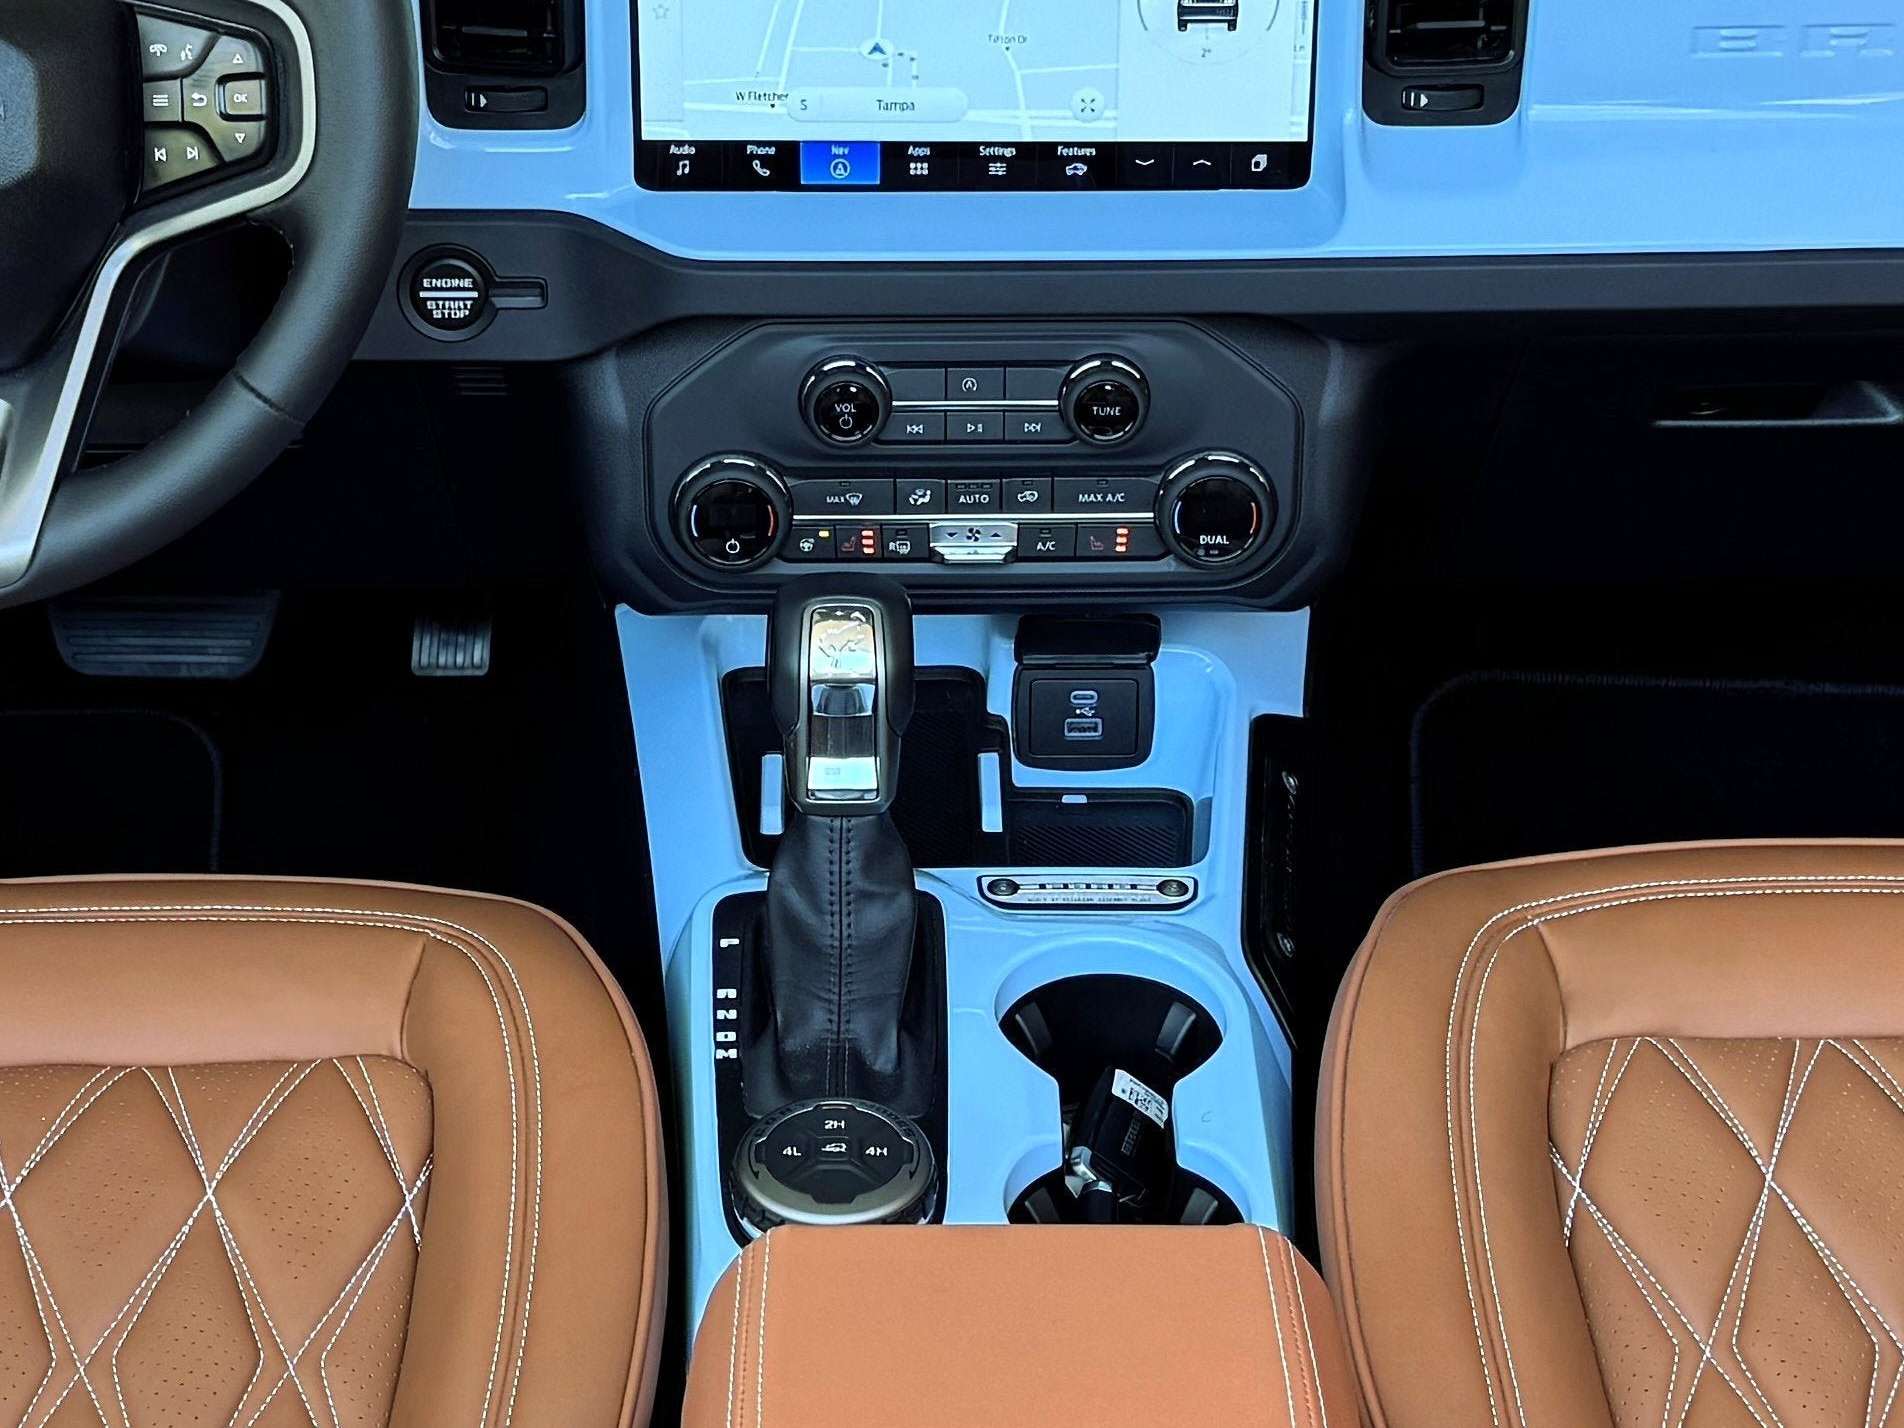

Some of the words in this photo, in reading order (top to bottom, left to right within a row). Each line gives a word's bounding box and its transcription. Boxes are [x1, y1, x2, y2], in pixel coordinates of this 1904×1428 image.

[799, 99, 809, 112] S
[876, 99, 915, 113] Tampa
[669, 144, 696, 155] Audio
[746, 144, 776, 155] Phone
[831, 145, 849, 155] Nav
[907, 145, 931, 157] Apps
[978, 145, 1016, 158] Settings
[1057, 145, 1096, 157] Features
[422, 278, 474, 289] ENGINE
[426, 300, 474, 310] START
[432, 309, 470, 319] STOP
[834, 403, 857, 413] VOL
[1092, 406, 1121, 416] TUNE
[825, 494, 845, 504] MAX
[958, 494, 990, 504] AUTO
[1078, 493, 1103, 503] MAX
[1105, 493, 1125, 503] A/C
[1199, 534, 1230, 545] DUAL
[1036, 541, 1056, 552] A/C
[716, 1009, 738, 1020] N
[824, 1120, 845, 1130] 2H
[782, 1146, 802, 1156] 4L
[864, 1146, 888, 1156] 4H
